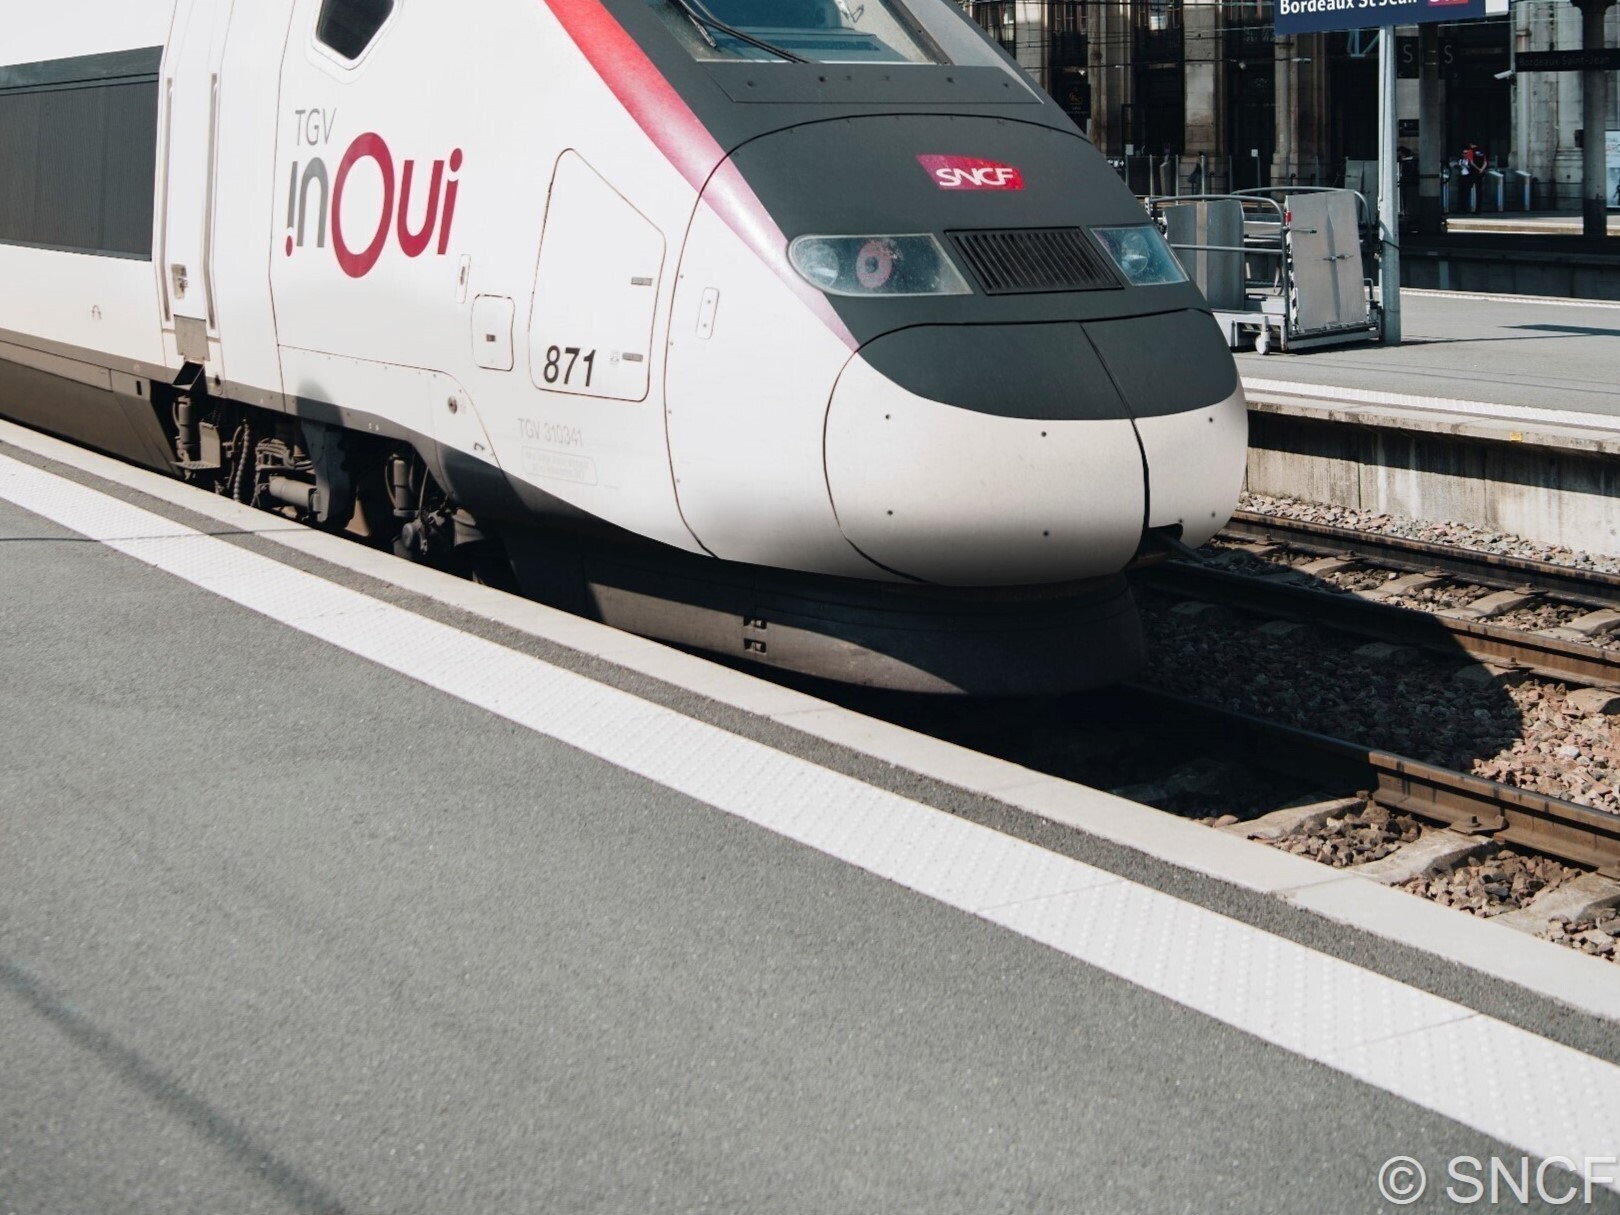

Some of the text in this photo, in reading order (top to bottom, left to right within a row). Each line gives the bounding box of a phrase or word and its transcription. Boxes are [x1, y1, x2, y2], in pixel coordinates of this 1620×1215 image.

[1403, 44, 1413, 63] S
[1444, 45, 1454, 64] S
[295, 107, 337, 146] TGV
[935, 168, 1014, 186] SNCF
[543, 345, 596, 387] 871
[517, 417, 540, 441] TGV
